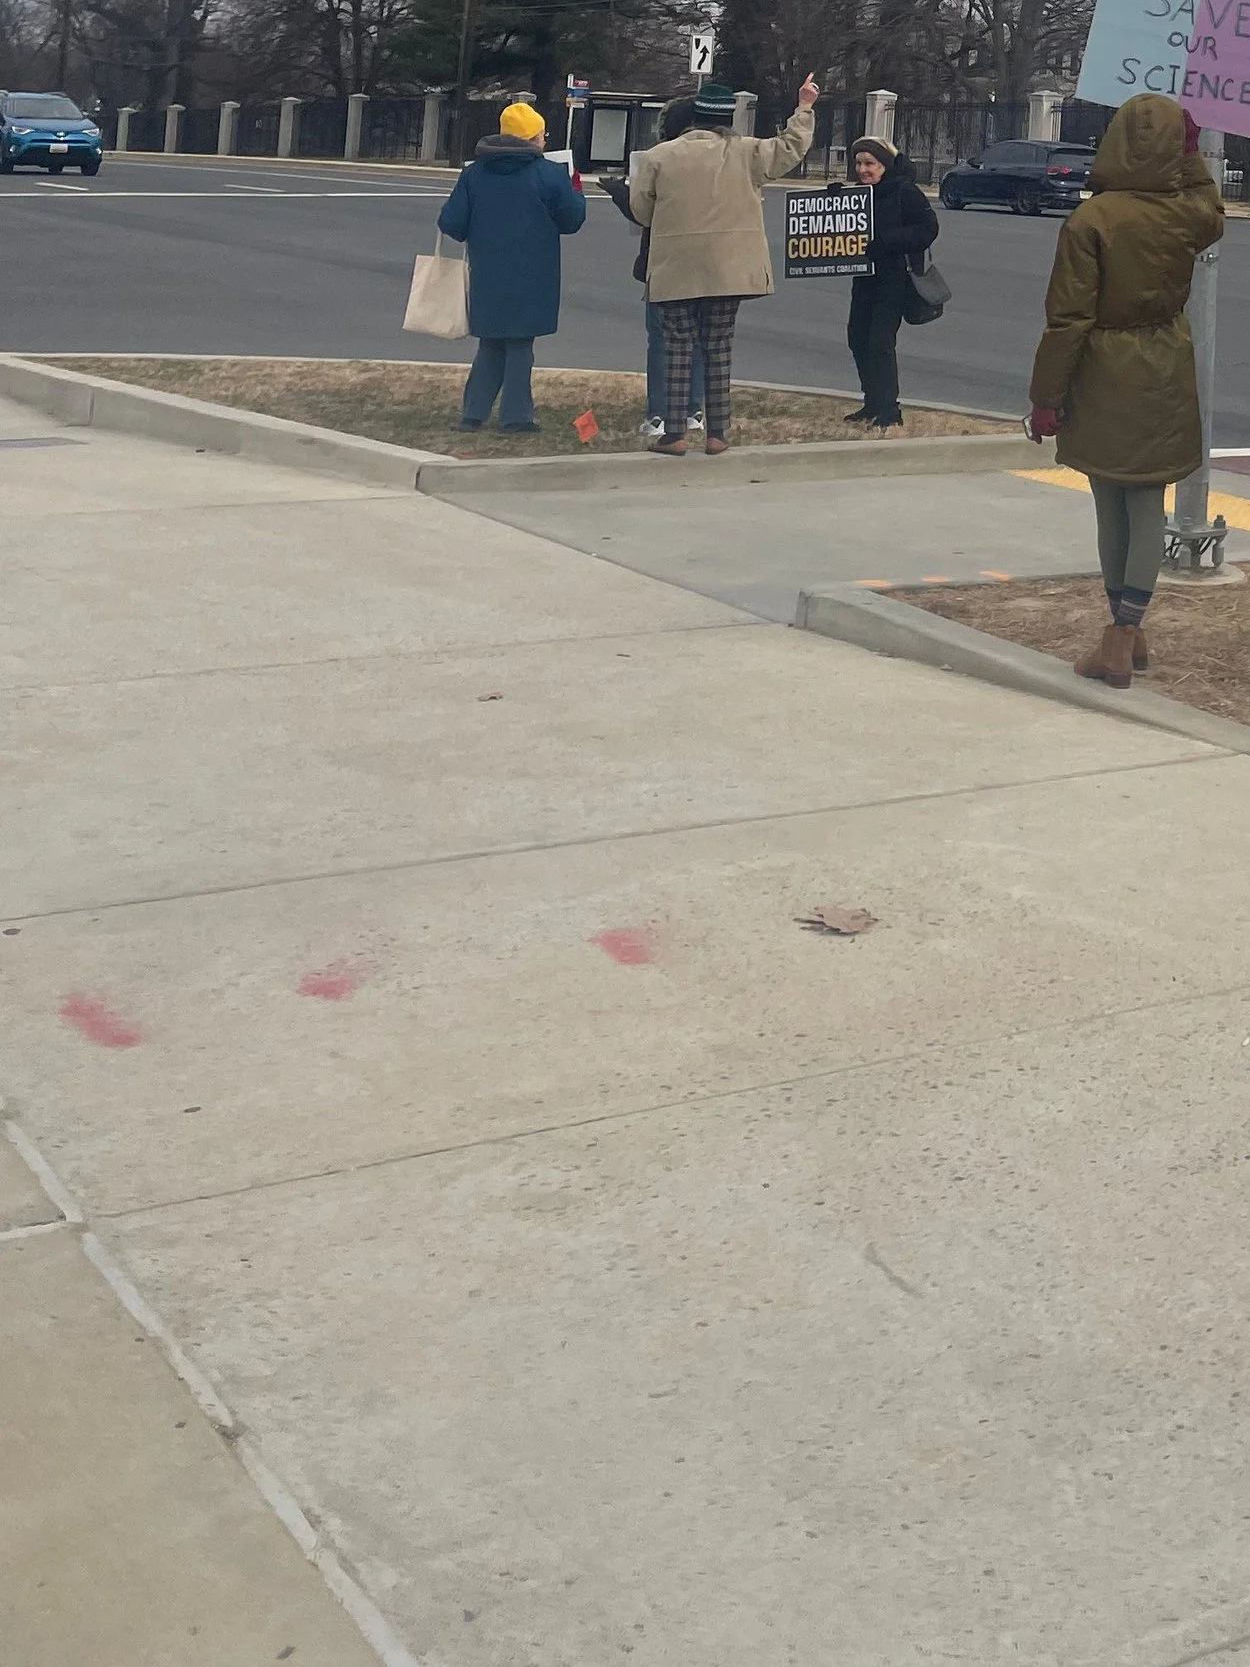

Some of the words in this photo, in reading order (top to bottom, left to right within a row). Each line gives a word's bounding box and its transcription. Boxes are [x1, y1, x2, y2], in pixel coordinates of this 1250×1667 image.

[1167, 31, 1218, 61] OUR
[789, 194, 868, 215] DEMOCRACY
[788, 212, 868, 235] DEMANDS
[788, 234, 869, 259] COURAGE
[805, 266, 835, 274] SERVANTS
[837, 265, 867, 273] COALITION
